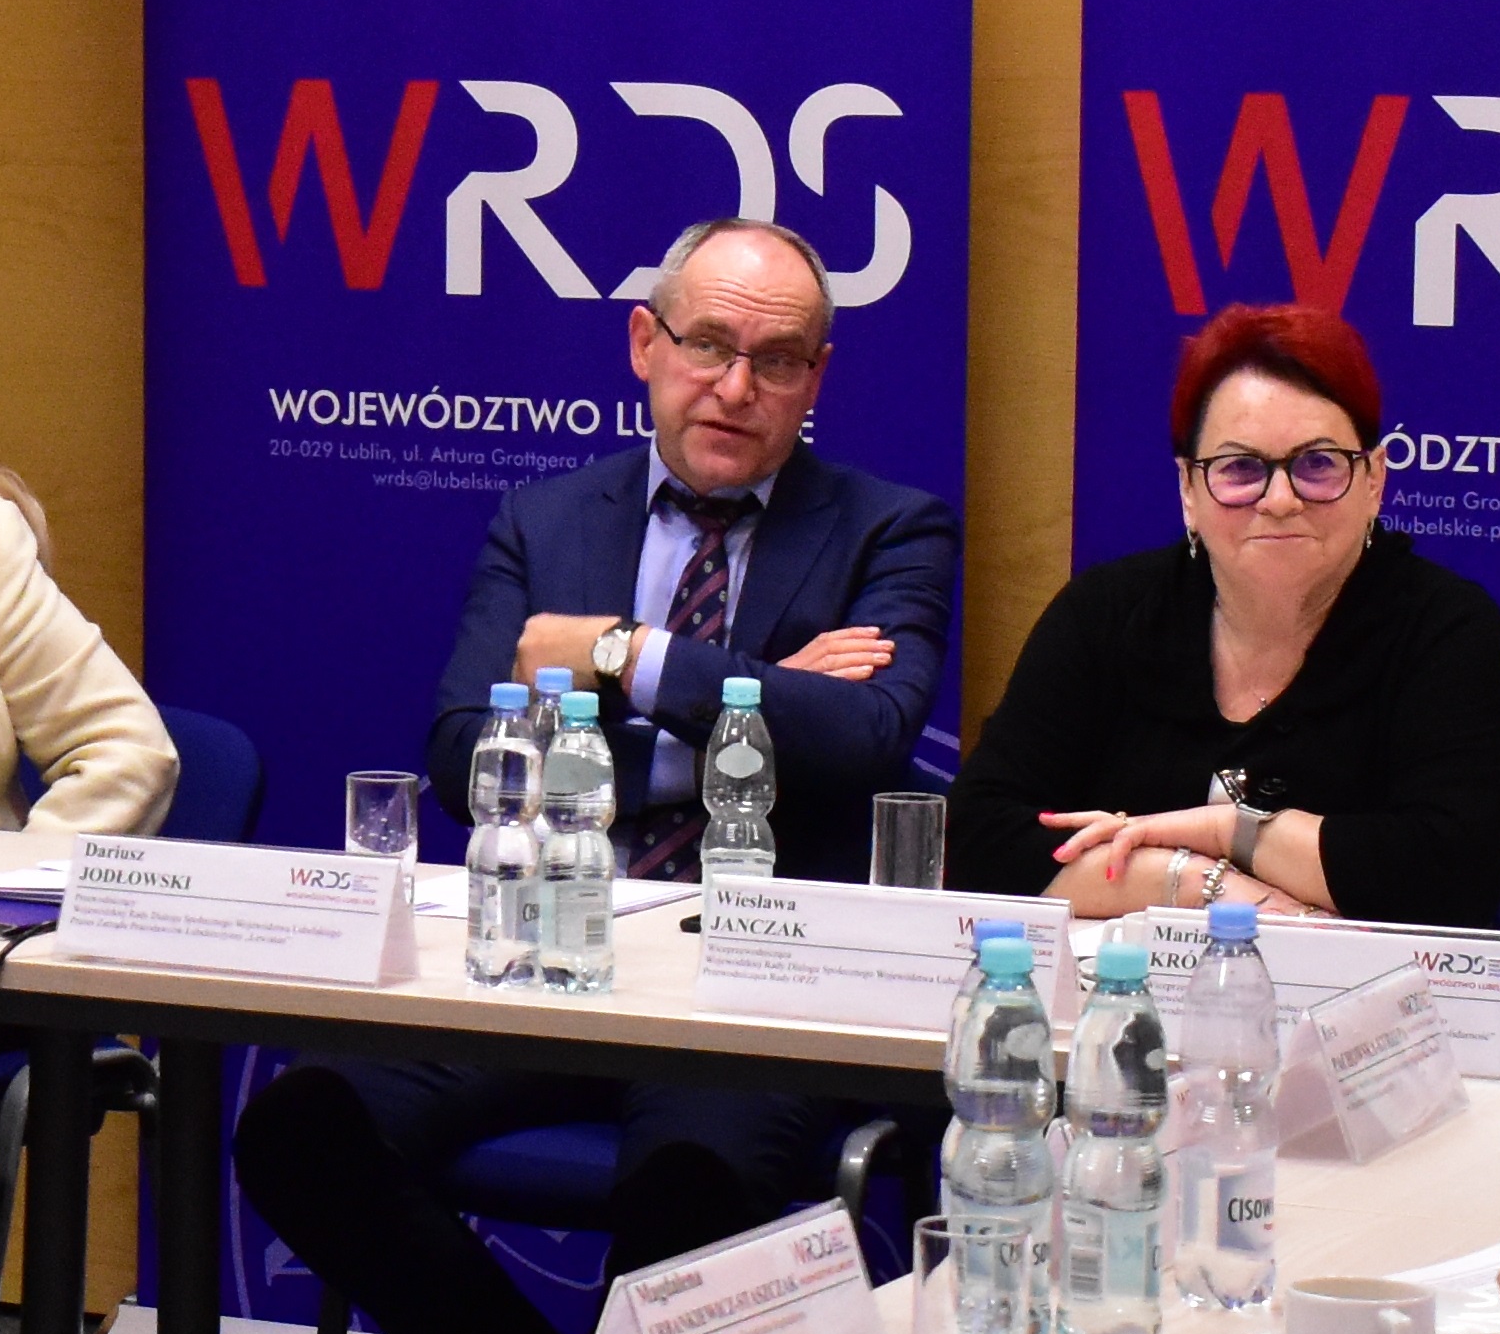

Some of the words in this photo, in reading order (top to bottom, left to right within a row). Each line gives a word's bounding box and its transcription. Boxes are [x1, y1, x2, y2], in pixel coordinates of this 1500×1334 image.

[185, 78, 913, 309] WRDS
[269, 385, 602, 437] WOJEWÓDZTWO
[269, 439, 334, 459] 20-029
[430, 446, 485, 465] Artura
[491, 448, 578, 472] Grottgera
[1392, 488, 1456, 509] Artura
[85, 841, 146, 861] Dariusz
[290, 867, 352, 890] WRDS
[710, 915, 808, 938] JANCZAK
[1153, 925, 1210, 945] Maria
[1150, 949, 1198, 970] KRÓ
